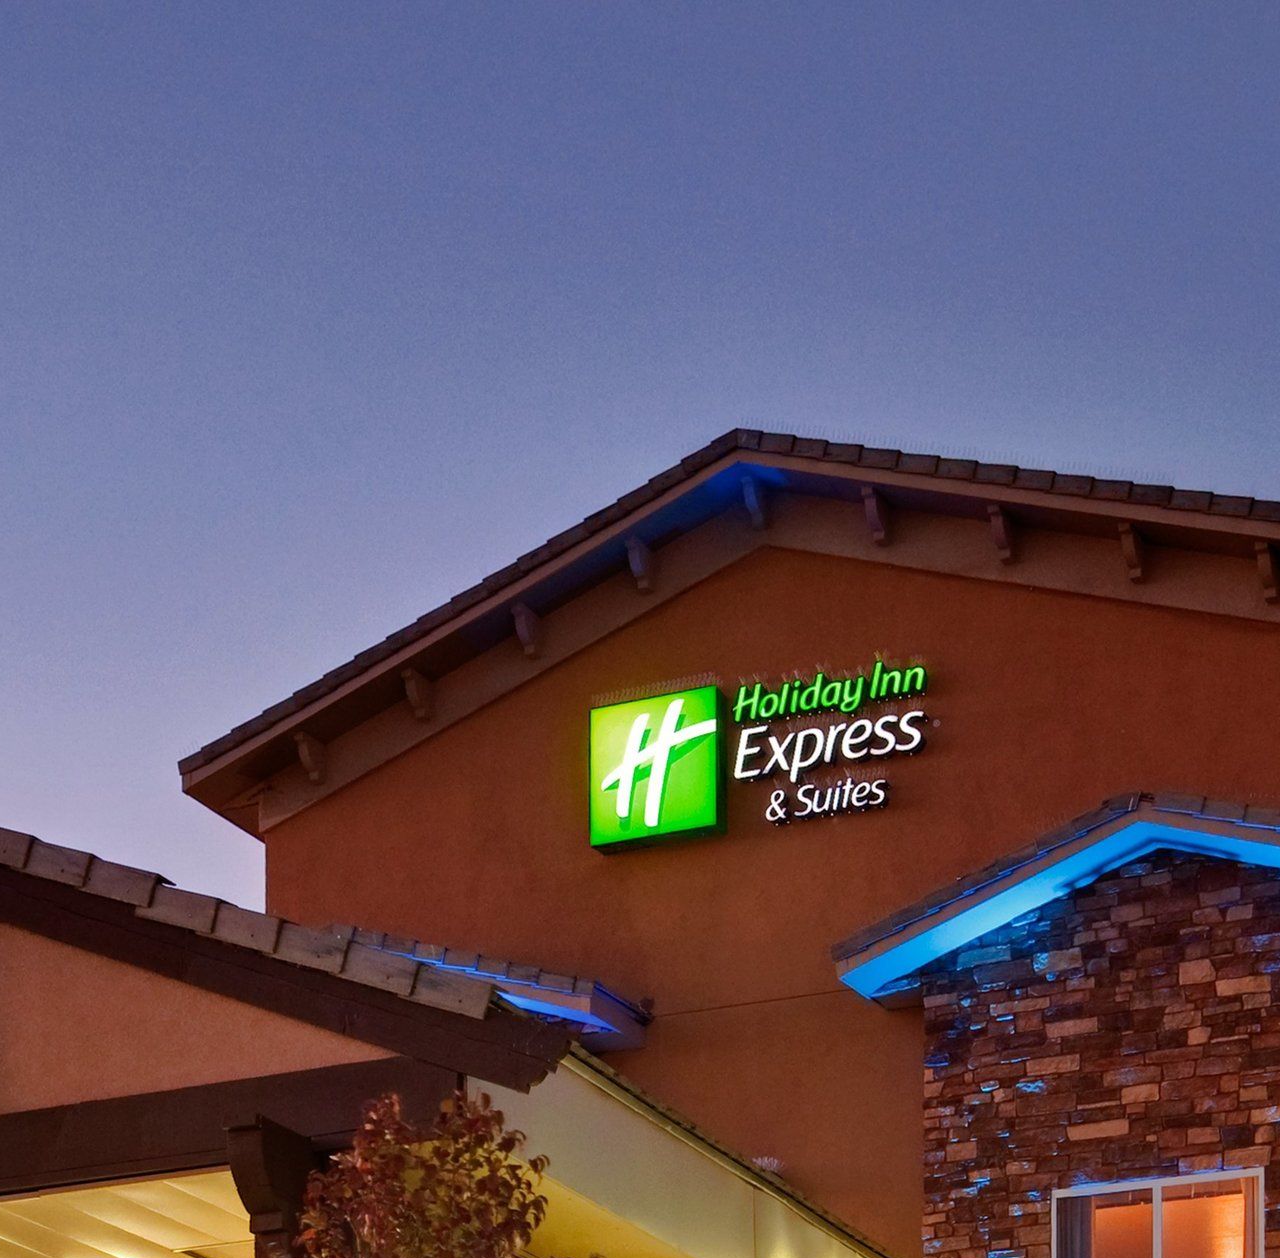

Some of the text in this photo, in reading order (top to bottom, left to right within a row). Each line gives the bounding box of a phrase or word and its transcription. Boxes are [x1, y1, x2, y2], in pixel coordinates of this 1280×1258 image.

[733, 661, 926, 722] Holiday Inn
[733, 710, 925, 784] Express
[765, 777, 887, 822] & Suites
